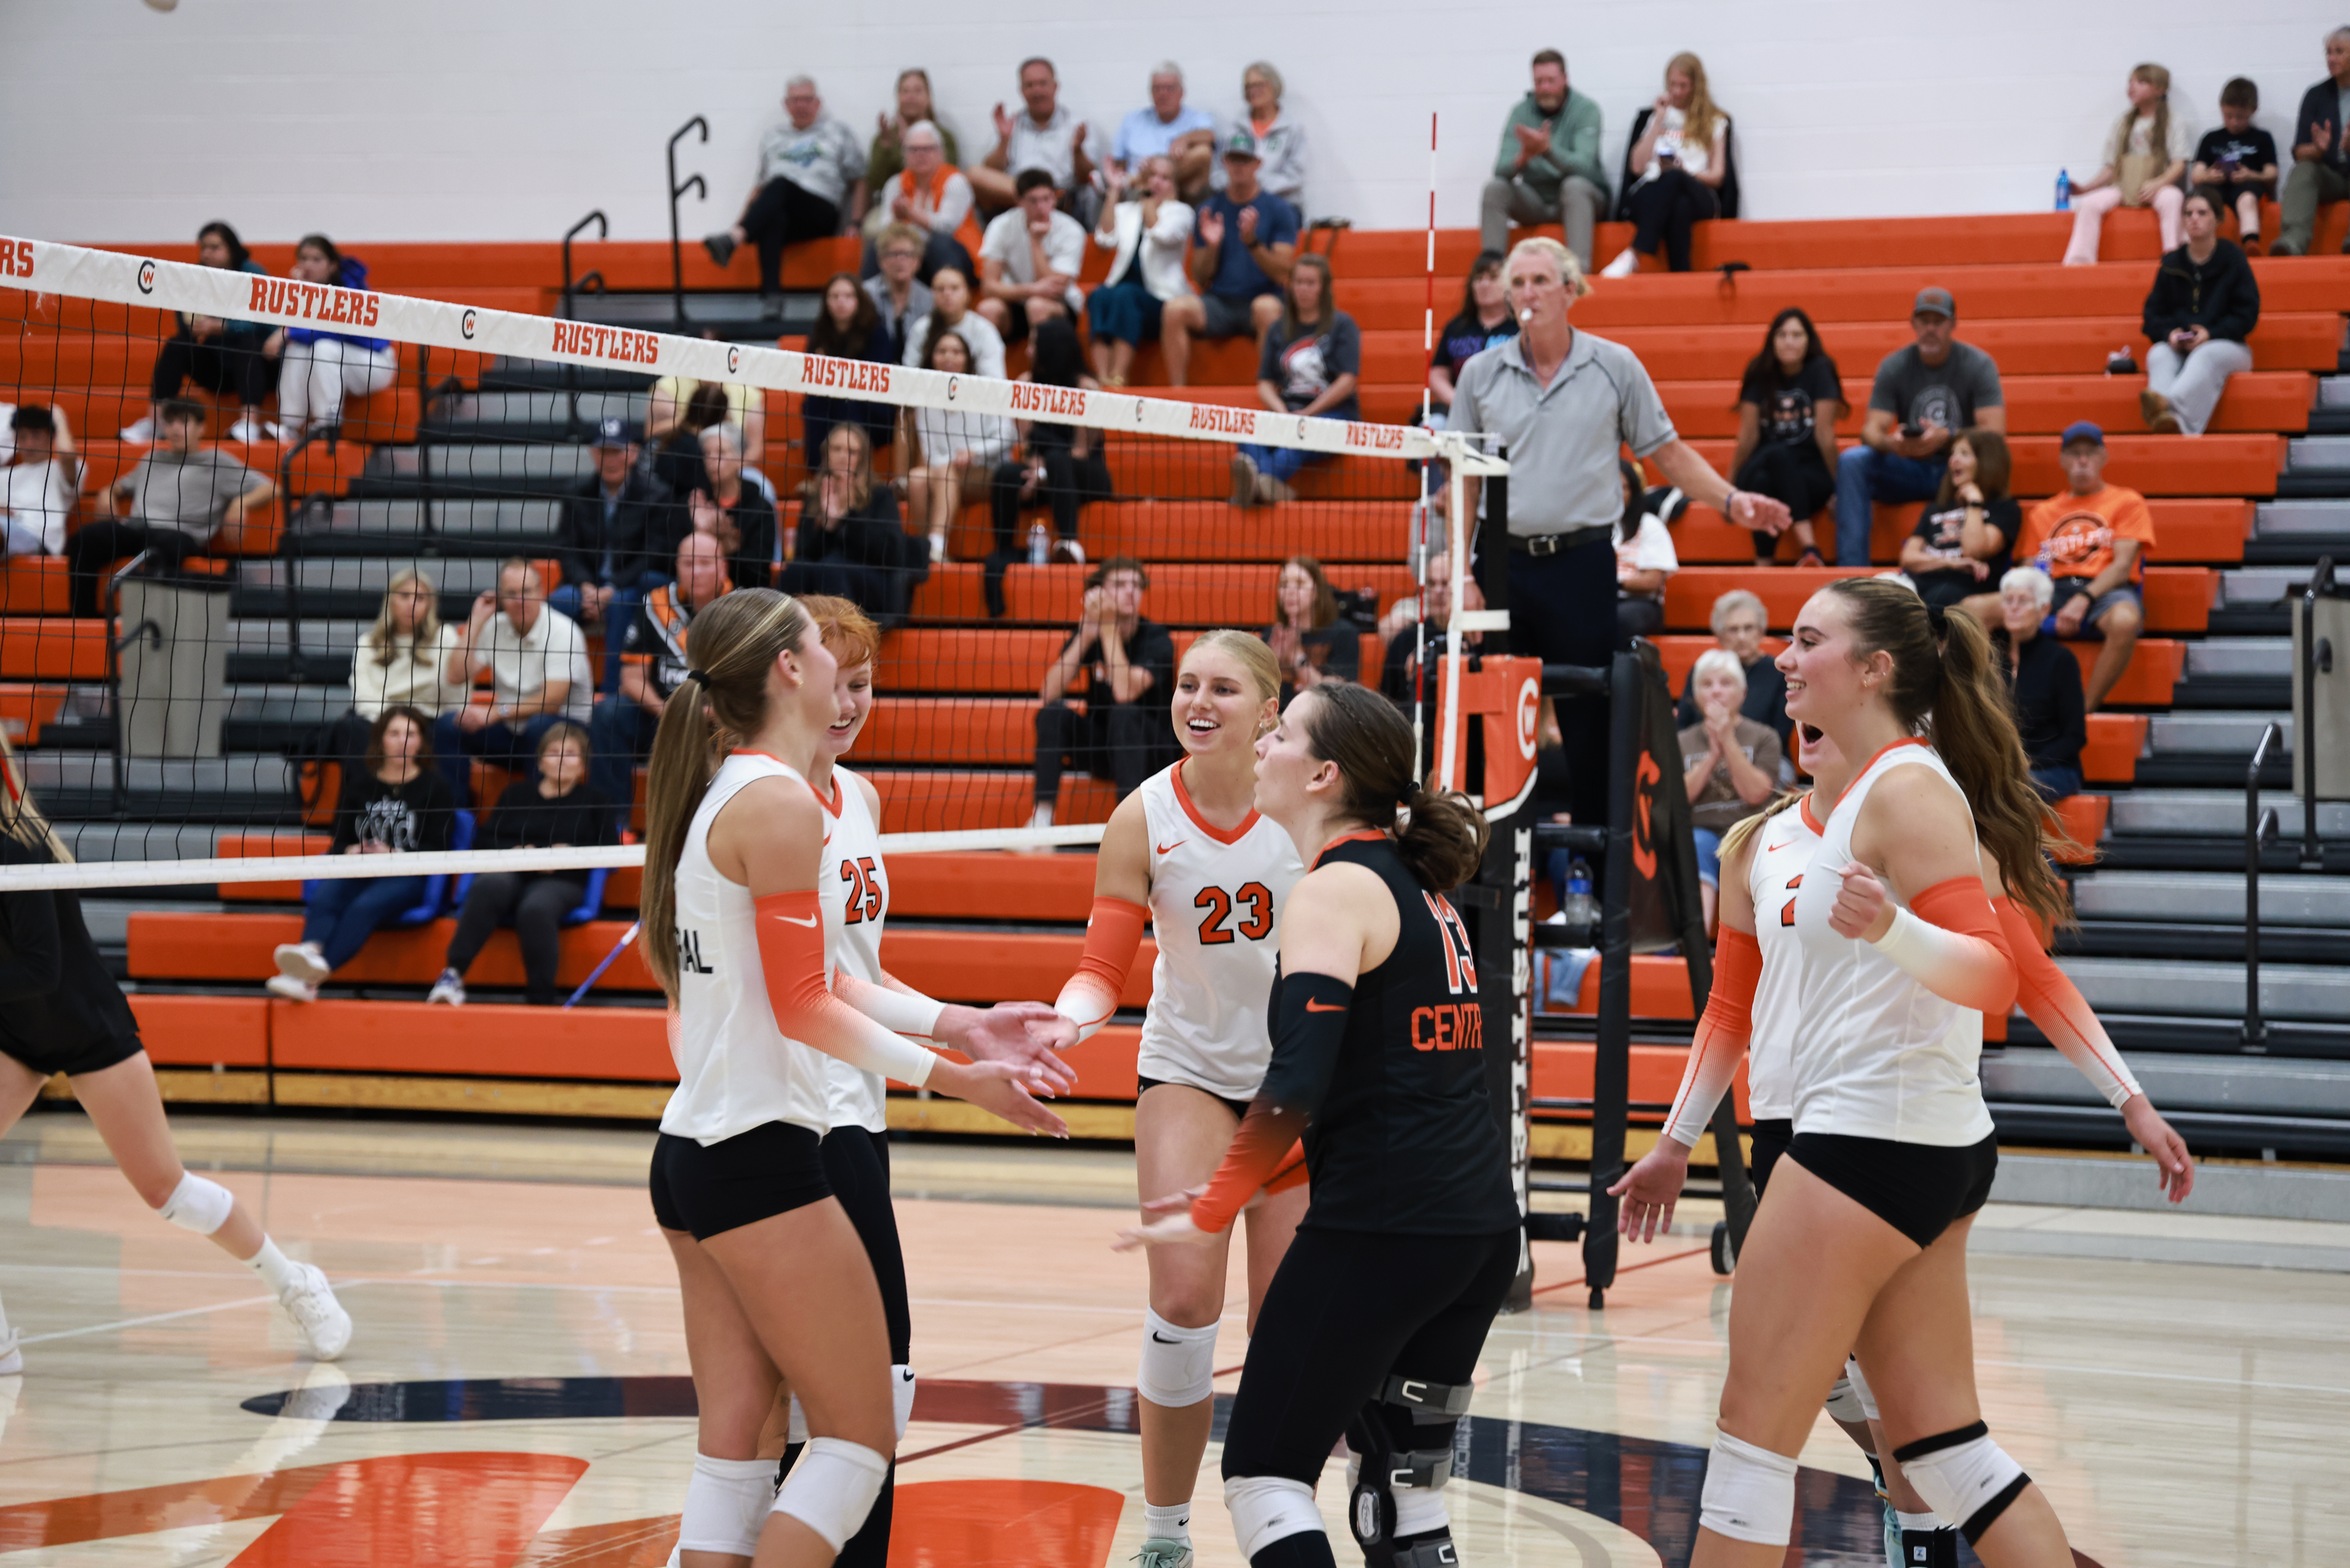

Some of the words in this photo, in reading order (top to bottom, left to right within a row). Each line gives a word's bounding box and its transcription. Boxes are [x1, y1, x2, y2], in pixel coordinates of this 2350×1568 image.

[249, 276, 380, 328] RUSTLERS
[551, 321, 659, 365] RUSTLERS
[801, 356, 891, 394] RUSTLERS
[1010, 380, 1086, 416] RUSTLERS
[1190, 405, 1255, 436] RUSTLERS
[1346, 422, 1405, 450] RUSTLERS
[840, 856, 882, 926] 25
[1194, 882, 1274, 946] 23
[674, 926, 713, 974] AL
